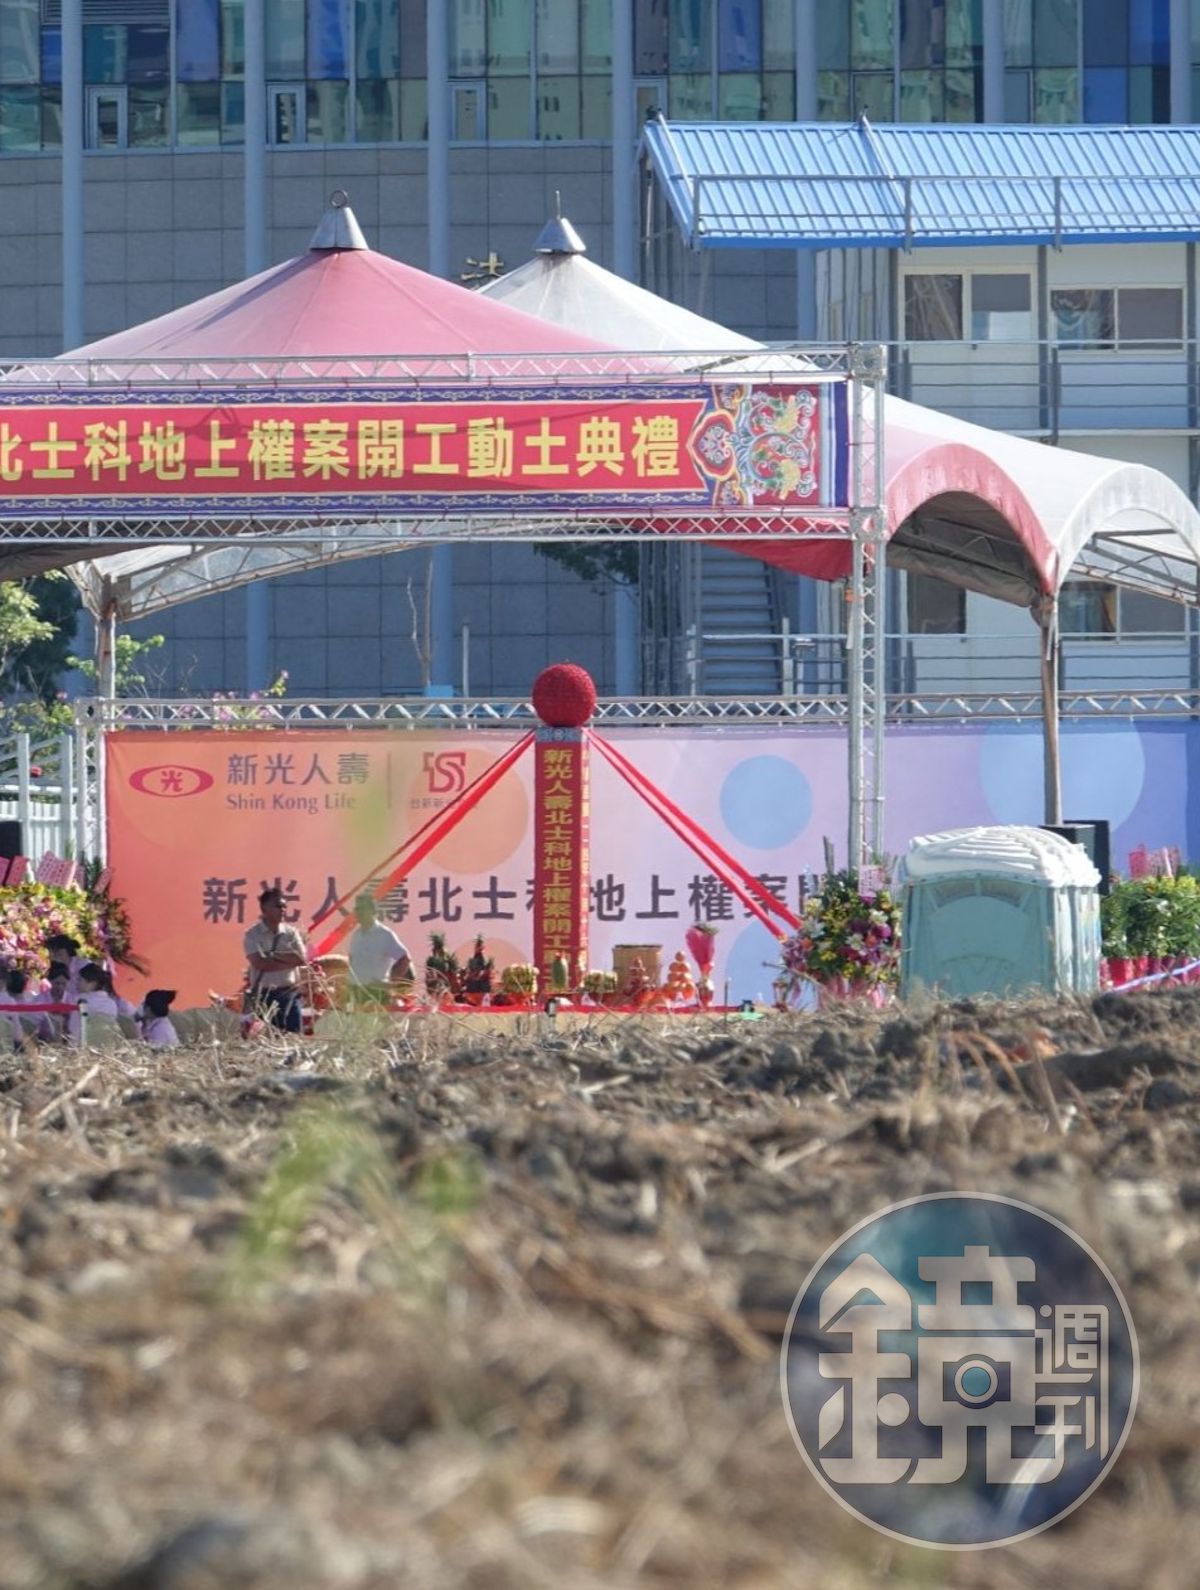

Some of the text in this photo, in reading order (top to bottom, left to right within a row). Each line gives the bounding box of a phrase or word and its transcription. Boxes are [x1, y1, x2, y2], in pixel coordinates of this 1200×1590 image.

[226, 752, 369, 786] 新光人壽
[226, 793, 357, 815] Shin Kong Life
